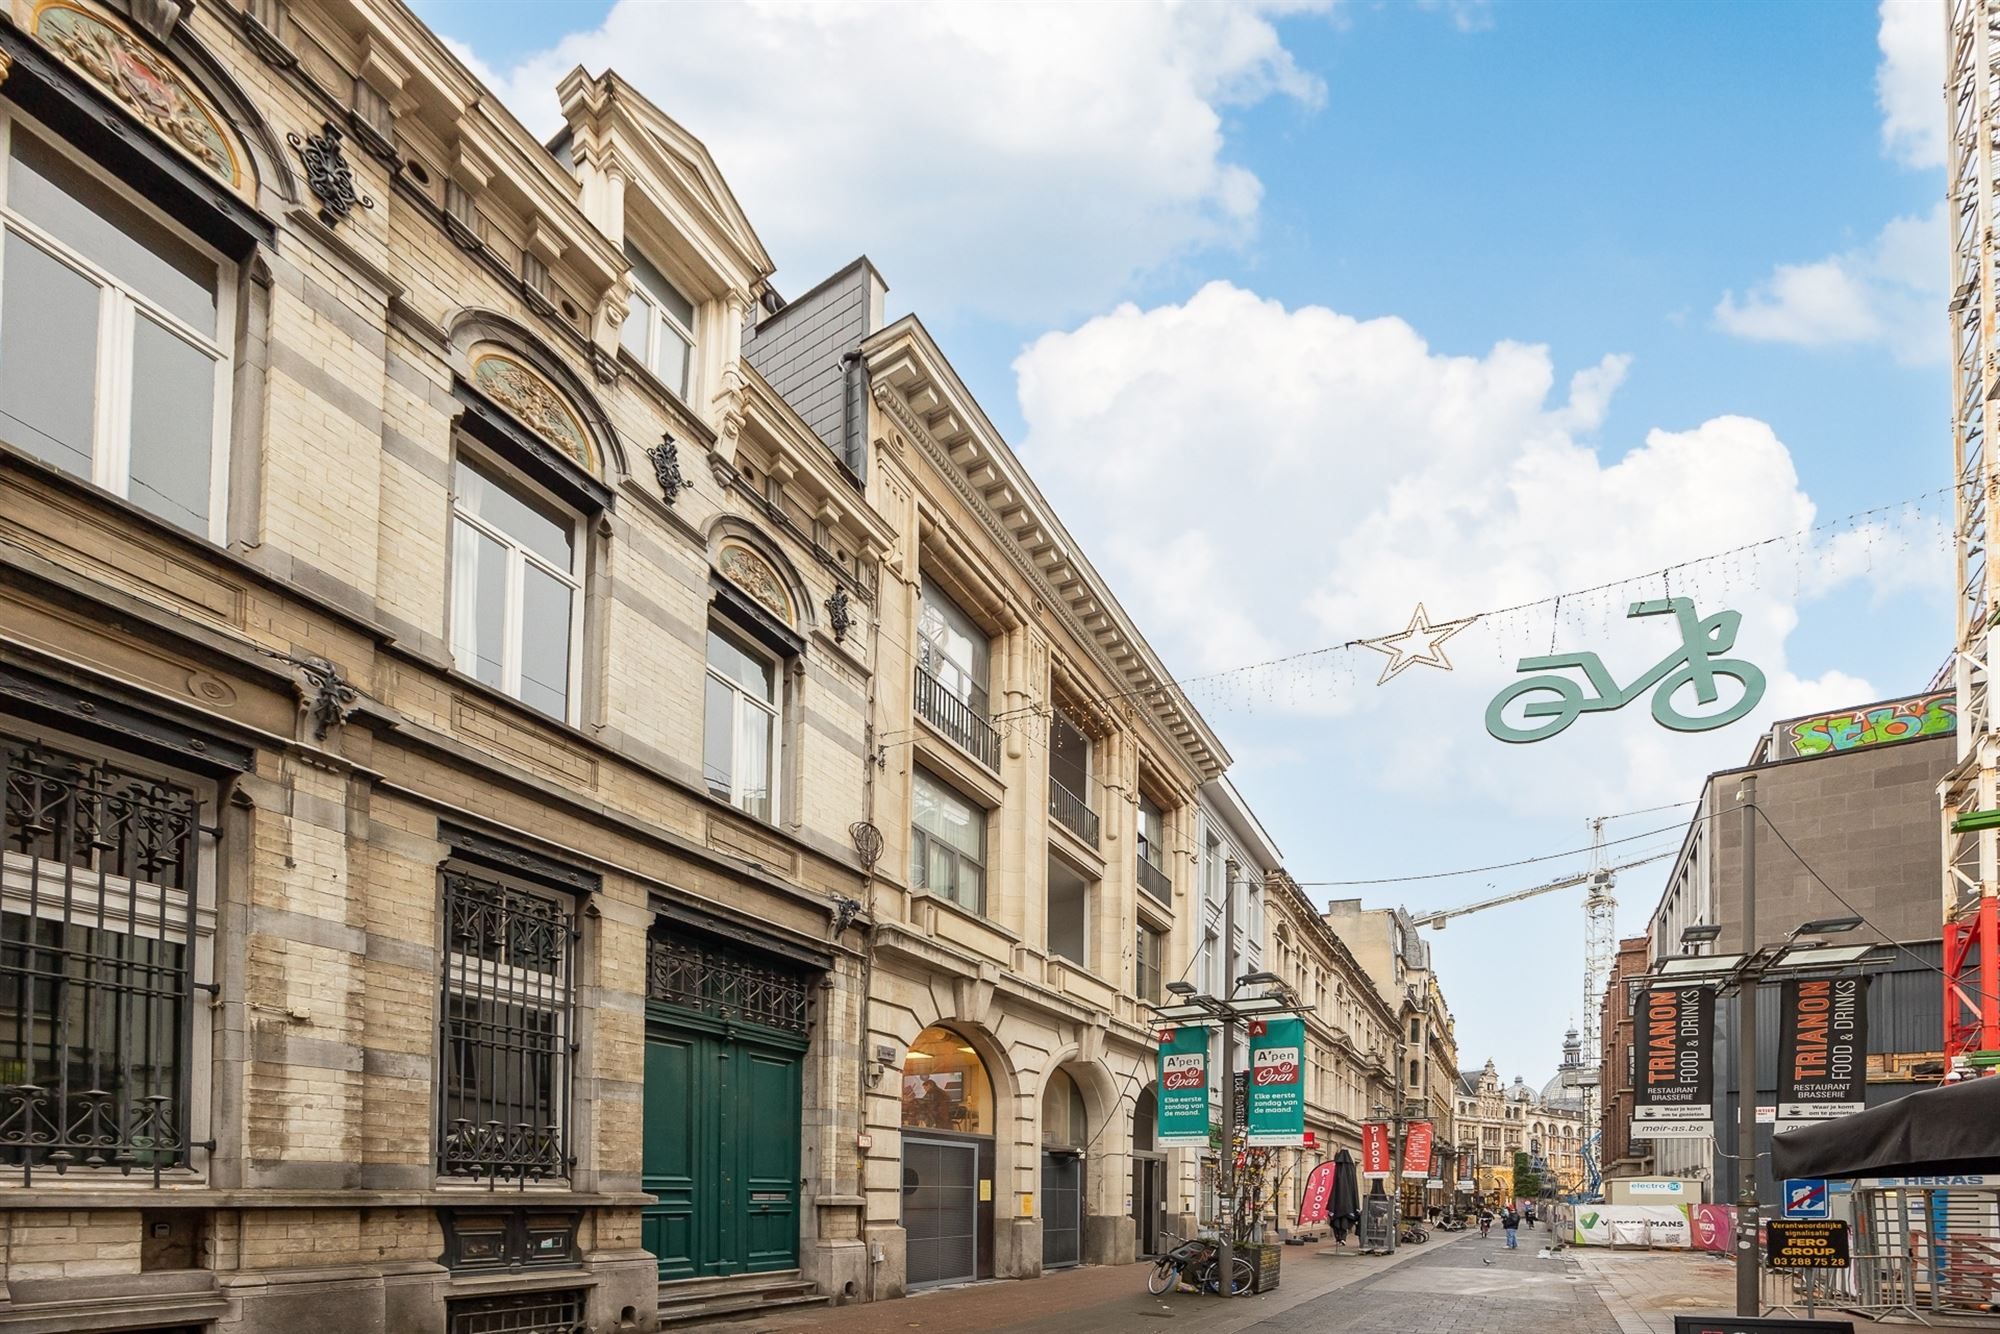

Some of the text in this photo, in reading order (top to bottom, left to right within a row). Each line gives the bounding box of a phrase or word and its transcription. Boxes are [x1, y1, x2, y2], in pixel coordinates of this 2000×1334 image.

[1681, 990, 1700, 1036] DRINKS
[1834, 980, 1856, 1030] DRINKS
[1162, 1033, 1171, 1041] A
[1254, 1025, 1263, 1034] A
[1648, 991, 1677, 1084] TRIANON
[1795, 981, 1830, 1081] TRIANON
[1680, 1050, 1699, 1083] FOOD
[1832, 1045, 1853, 1080] FOOD
[1167, 1072, 1200, 1090] Open
[1257, 1068, 1294, 1086] Open
[1793, 1083, 1852, 1091] RESTAURANT
[1642, 1122, 1704, 1133] meir-as.be
[1371, 1126, 1380, 1170] pipoos
[1311, 1168, 1330, 1217] pipoos
[1904, 1176, 1983, 1185] HERAS
[1831, 1258, 1845, 1266] 28
